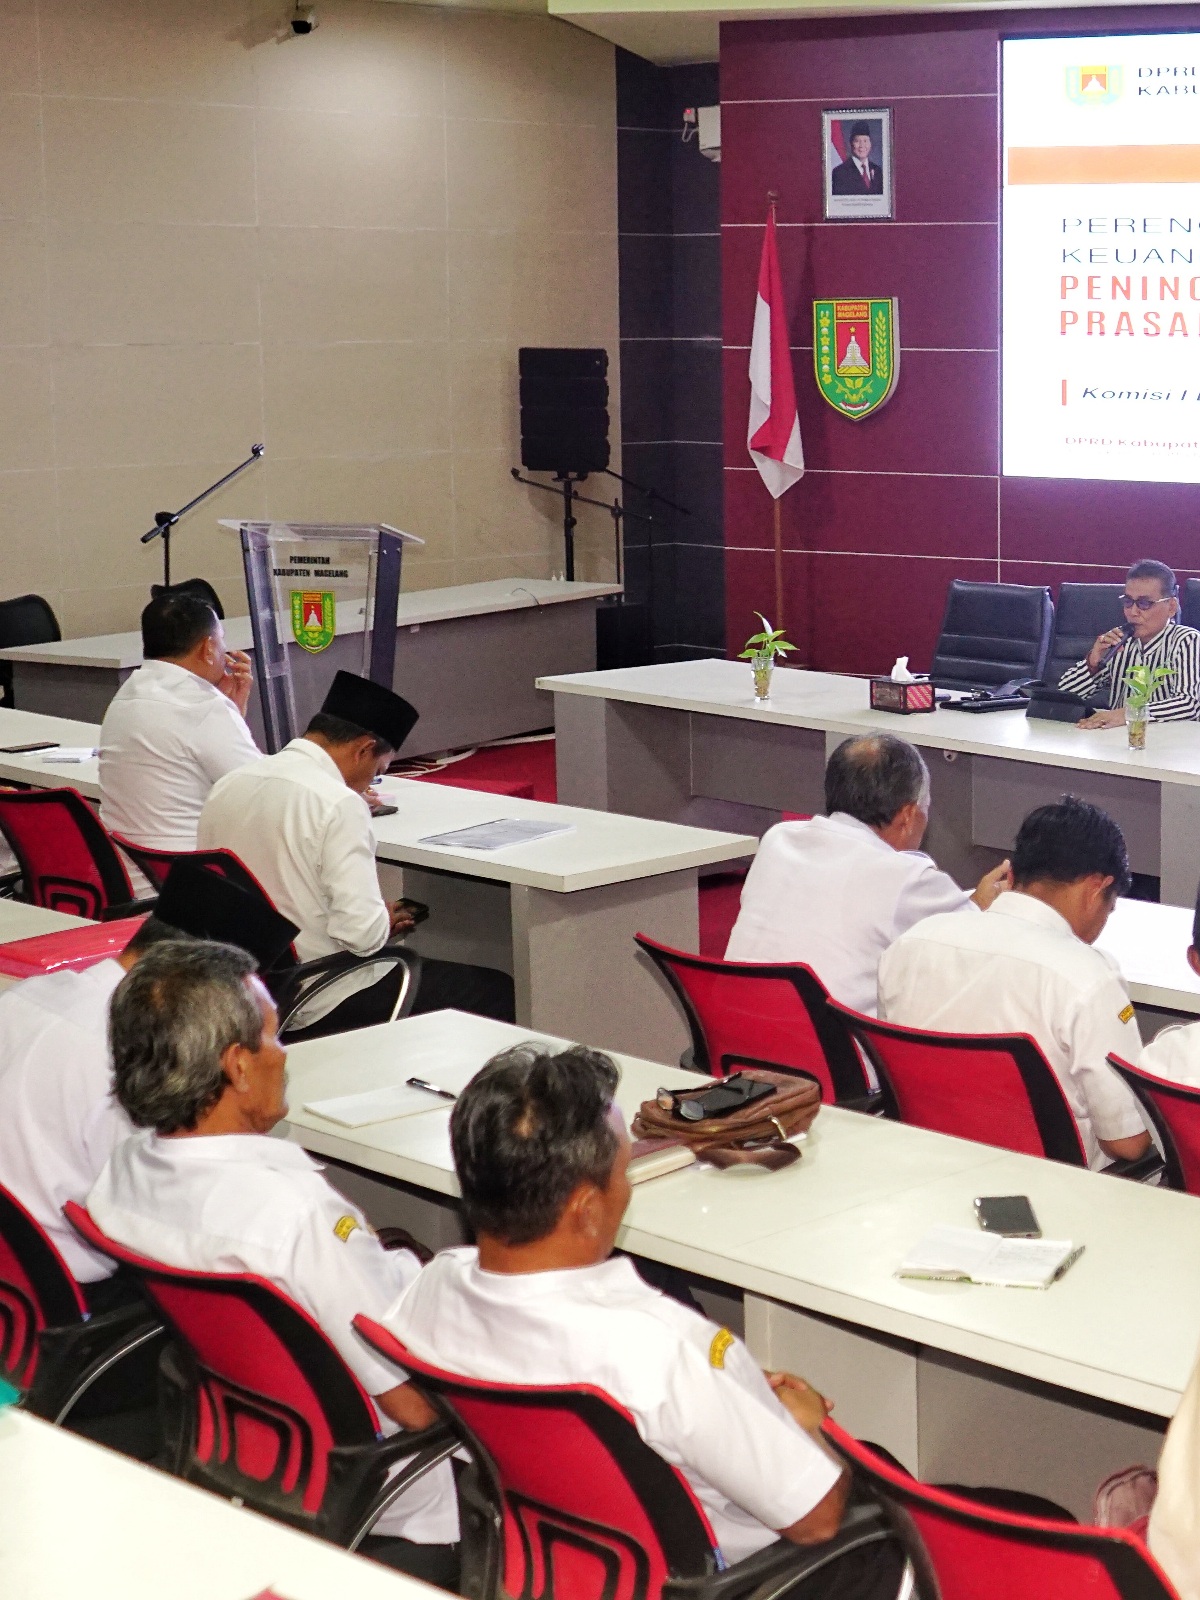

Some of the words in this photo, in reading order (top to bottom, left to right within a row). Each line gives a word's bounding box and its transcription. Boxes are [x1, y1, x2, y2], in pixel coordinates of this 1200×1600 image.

[1082, 387, 1172, 401] Komisi
[1180, 389, 1188, 401] I
[1065, 437, 1113, 446] DPRD
[289, 556, 330, 565] PEMERINTAH
[273, 568, 311, 577] KABUPATEN
[314, 569, 349, 578] MAGELANG
